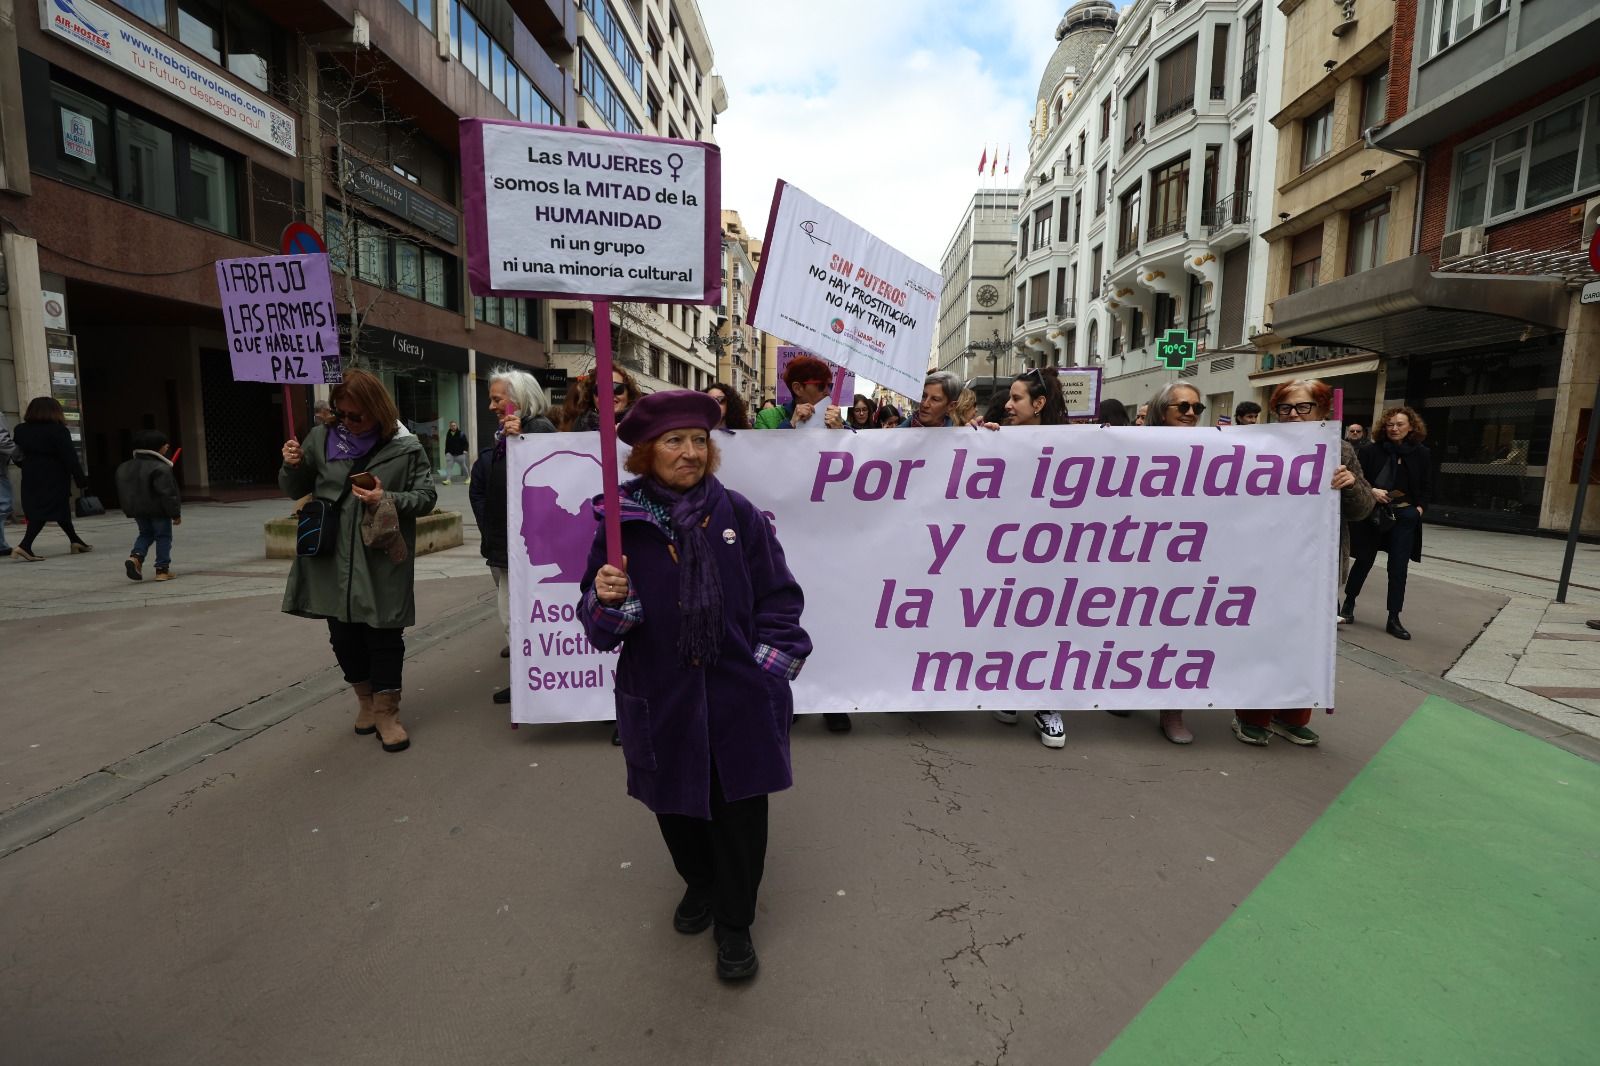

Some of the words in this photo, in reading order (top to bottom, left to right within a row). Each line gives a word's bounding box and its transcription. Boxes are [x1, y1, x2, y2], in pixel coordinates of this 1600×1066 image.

[55, 15, 111, 49] AIR-HOSTESS
[119, 29, 266, 119] www.trabajarvolando.com
[131, 50, 146, 69] Tu
[149, 60, 186, 90] Futuro
[189, 85, 237, 117] despega
[239, 110, 261, 129] aquí
[528, 147, 563, 166] Las
[567, 150, 663, 175] MUJERES
[493, 176, 560, 194] somos
[564, 178, 581, 196] la
[586, 181, 651, 201] MITAD
[655, 188, 678, 205] de
[682, 190, 698, 207] la
[535, 205, 662, 230] HUMANIDAD
[550, 234, 565, 249] ni
[569, 239, 590, 251] un
[594, 240, 645, 257] grupo
[503, 257, 518, 272] ni
[522, 261, 555, 274] una
[559, 261, 624, 278] minoría
[628, 265, 693, 282] cultural
[829, 253, 854, 278] SIN
[855, 267, 907, 308] PUTEROS
[809, 264, 827, 281] NO
[828, 275, 851, 293] HAY
[851, 286, 917, 330] PROSTITUCIÓN
[228, 303, 265, 334] LAS
[825, 291, 843, 307] NO
[845, 301, 867, 320] HAY
[867, 312, 897, 338] TRATA
[233, 336, 262, 354] QUE
[265, 332, 305, 353] HABLE
[306, 331, 325, 353] LA
[270, 355, 309, 381] PAZ
[810, 451, 926, 503] Por
[945, 448, 1007, 500] la
[1030, 443, 1328, 509] igualdad
[926, 523, 966, 575] y
[986, 514, 1210, 565] contra
[530, 599, 575, 624] Aso
[874, 578, 935, 629] la
[959, 575, 1258, 629] violencia
[522, 638, 532, 657] a
[528, 664, 604, 692] Sexual
[911, 640, 1217, 692] machista
